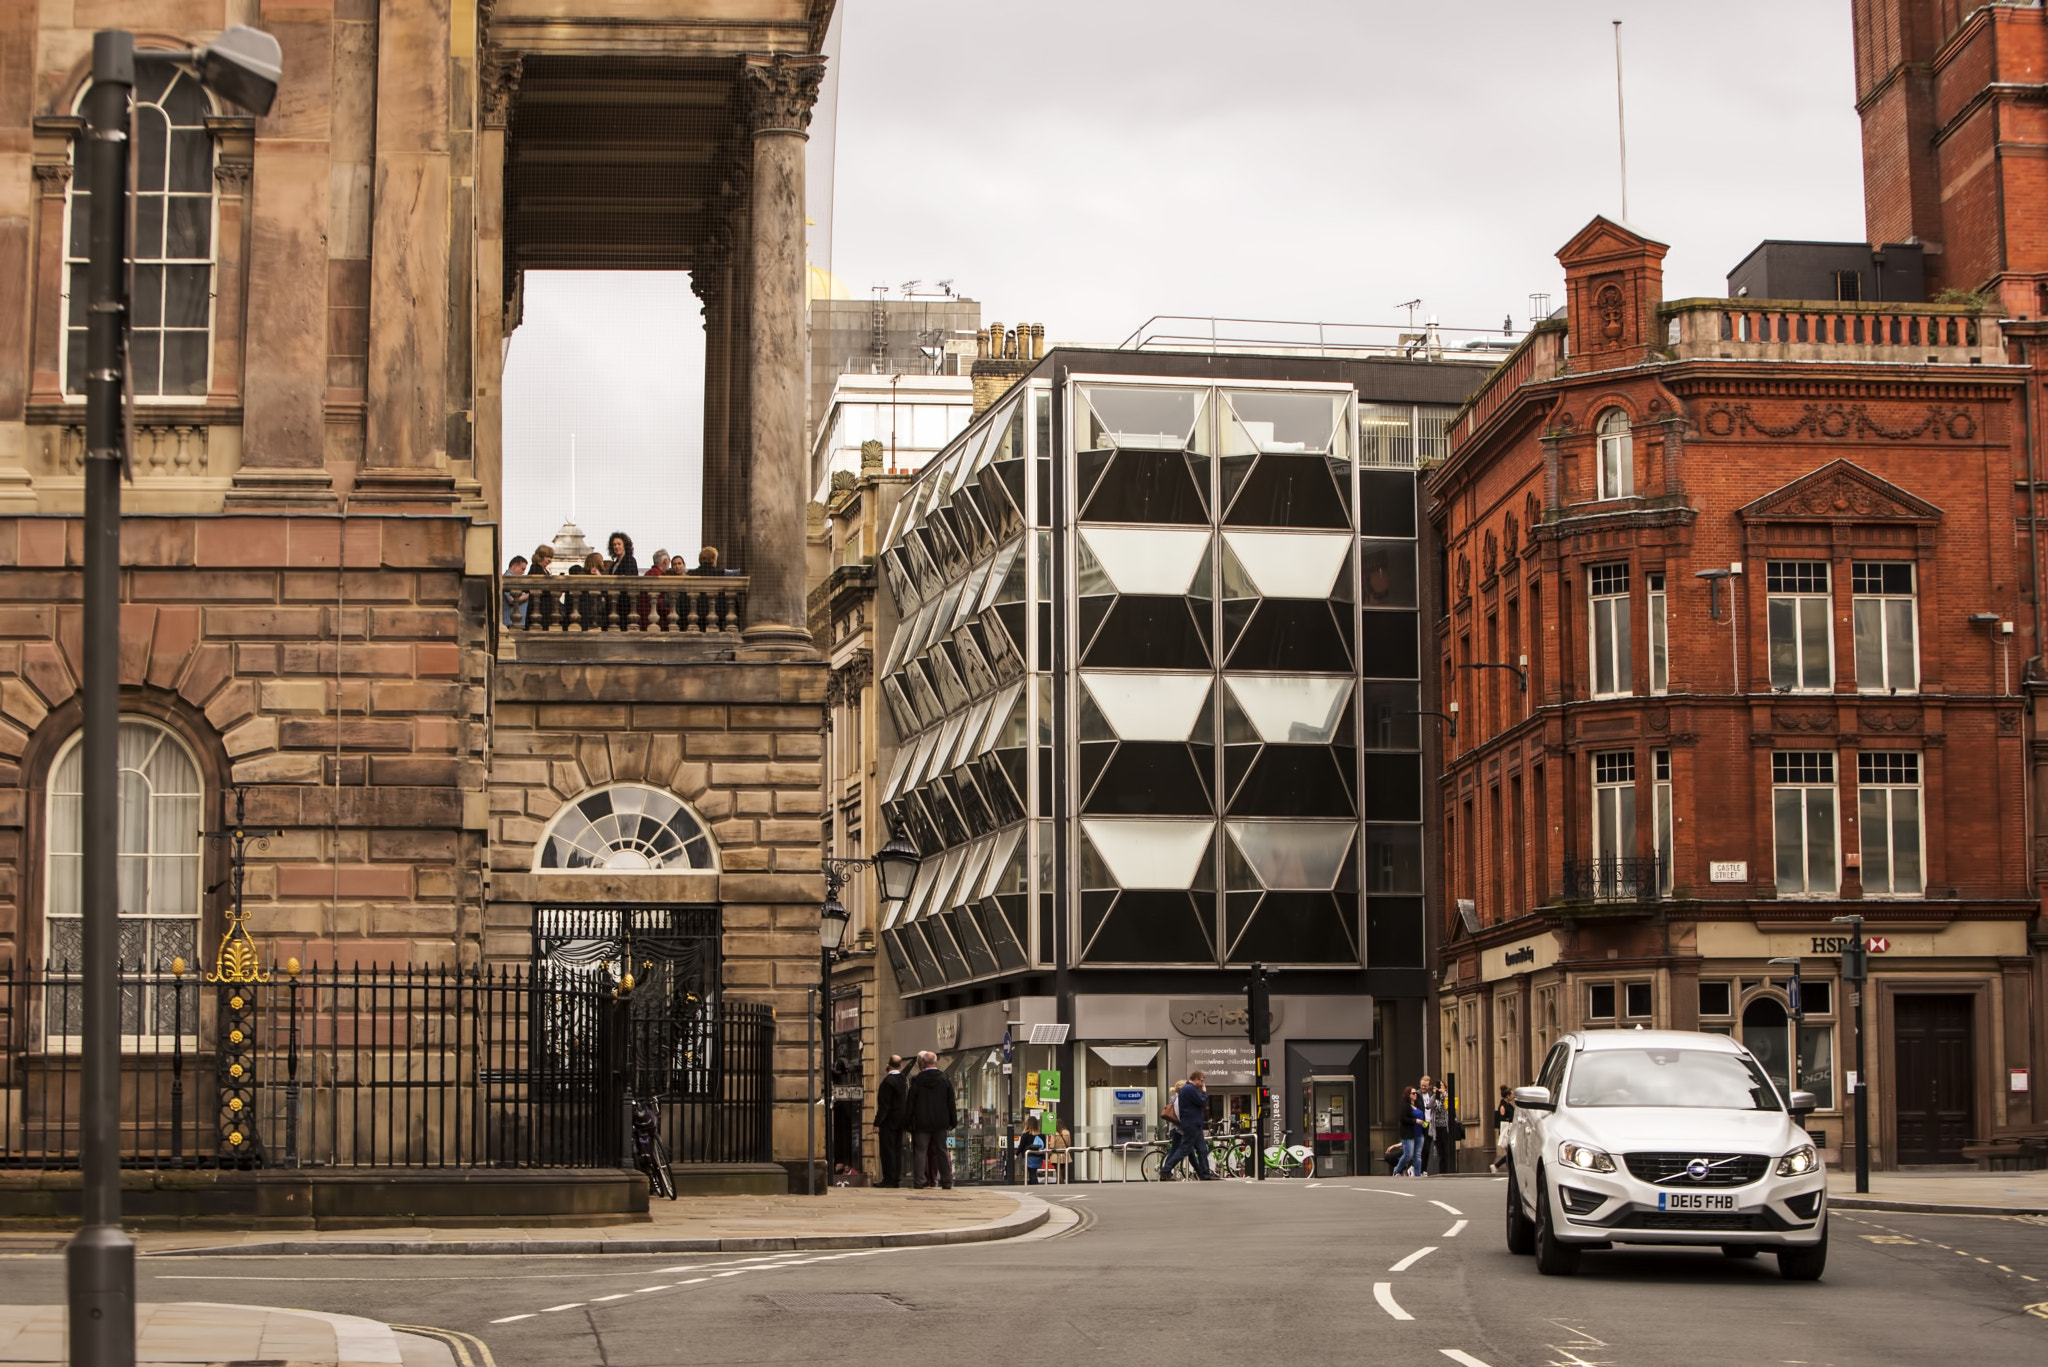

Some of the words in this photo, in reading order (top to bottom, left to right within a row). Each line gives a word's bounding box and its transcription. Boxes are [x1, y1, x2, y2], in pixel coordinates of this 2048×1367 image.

[1811, 937, 1855, 953] HSB
[1671, 1195, 1702, 1208] DE15
[1706, 1196, 1733, 1209] FHB
